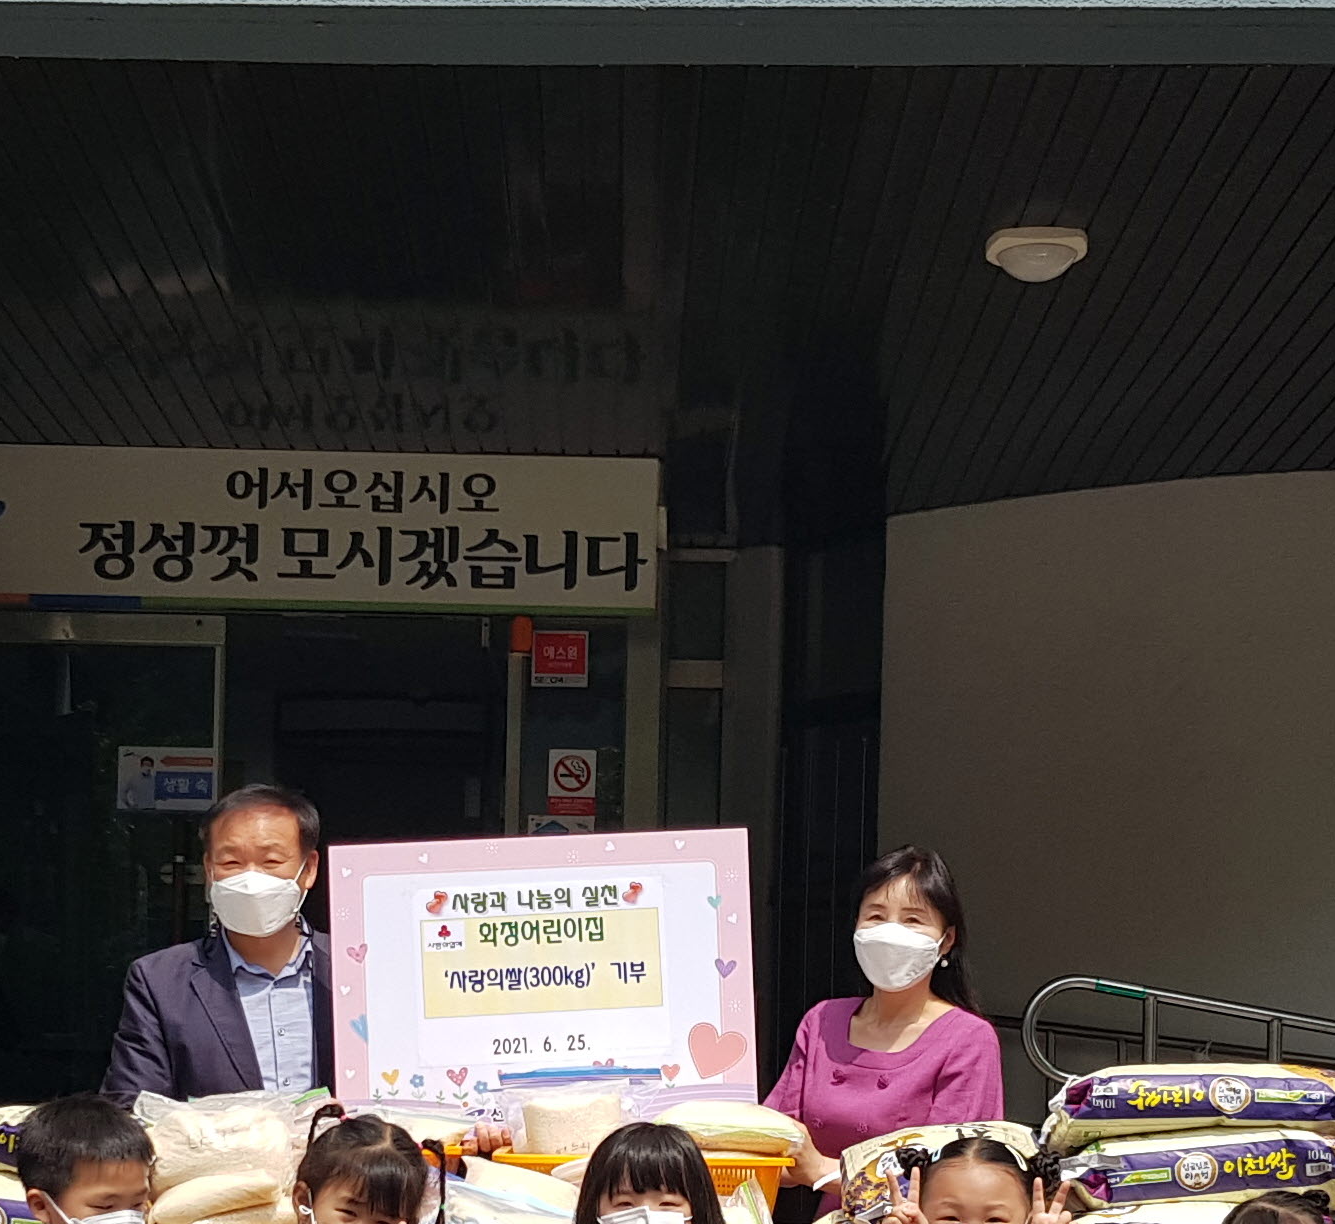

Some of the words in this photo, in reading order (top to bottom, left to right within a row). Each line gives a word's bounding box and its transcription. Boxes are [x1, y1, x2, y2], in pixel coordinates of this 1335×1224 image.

[225, 467, 500, 514] 어서오십시오
[78, 520, 262, 583] 정성껏
[277, 525, 649, 591] 모시겠습니다
[452, 889, 507, 914] 사랑과
[517, 887, 571, 911] 나눔의
[582, 884, 619, 906] 실천
[479, 916, 604, 947] 화정어린이집
[610, 962, 647, 985] 기부
[492, 1036, 533, 1056] 2021.
[543, 1036, 558, 1053] 6.
[566, 1034, 591, 1051] 25.
[1127, 1080, 1204, 1110] 이천쌀
[1224, 1149, 1296, 1180] 이천쌀
